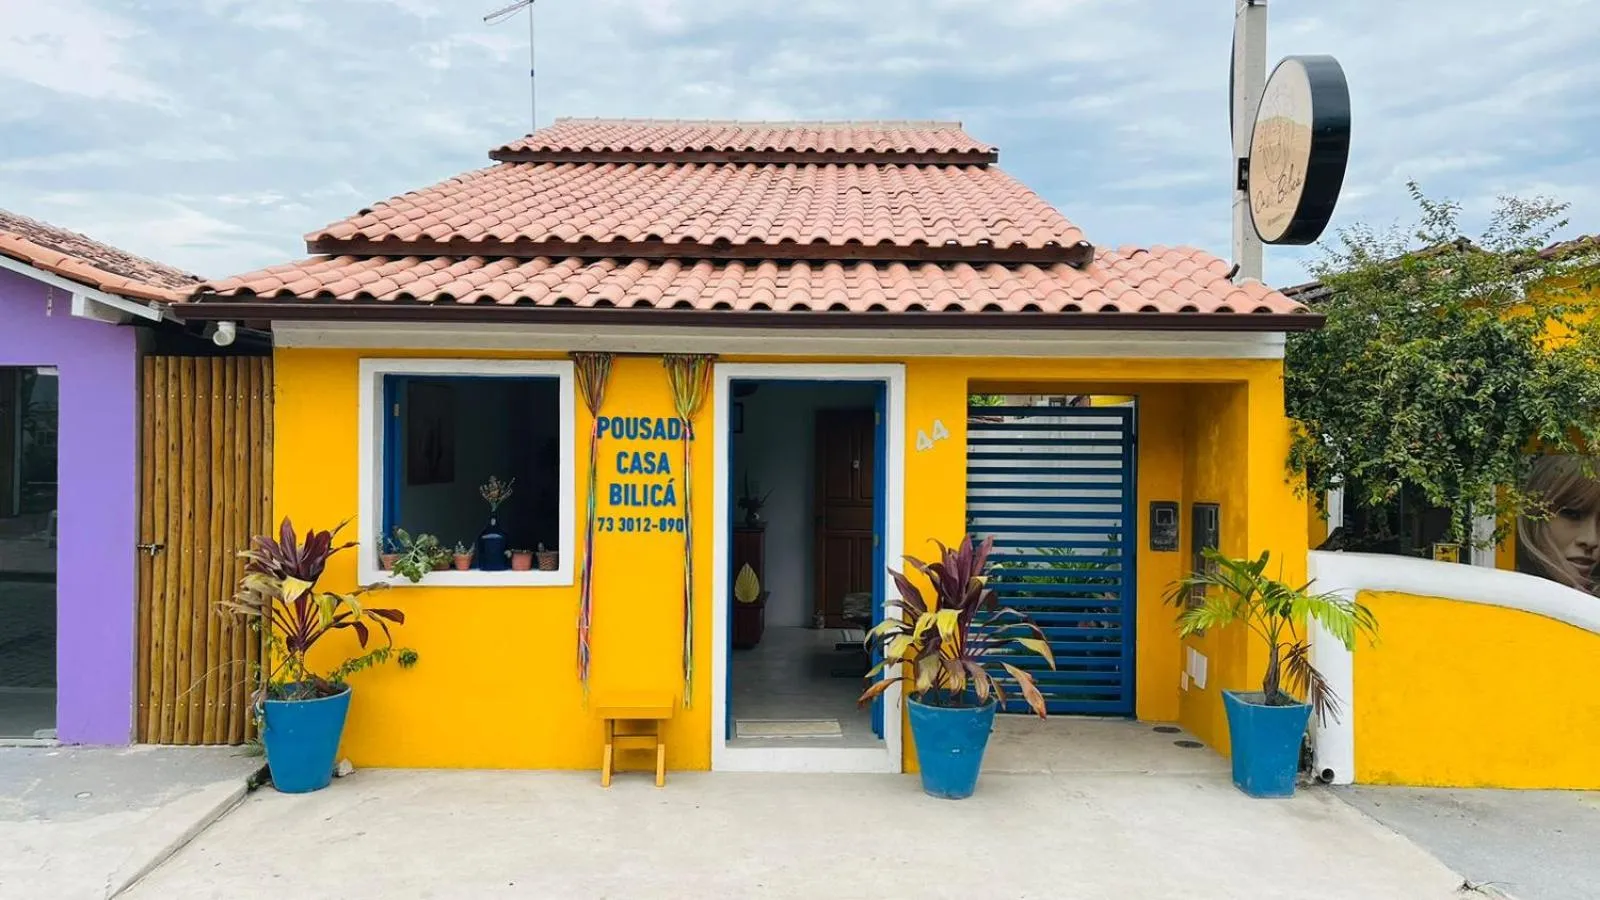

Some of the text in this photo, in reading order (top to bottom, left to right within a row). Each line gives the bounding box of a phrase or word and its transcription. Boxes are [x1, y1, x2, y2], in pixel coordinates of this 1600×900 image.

[916, 419, 949, 452] 44
[616, 452, 670, 474] CASA
[609, 478, 676, 507] BILICÁ
[597, 517, 690, 532] 73 3012-890
